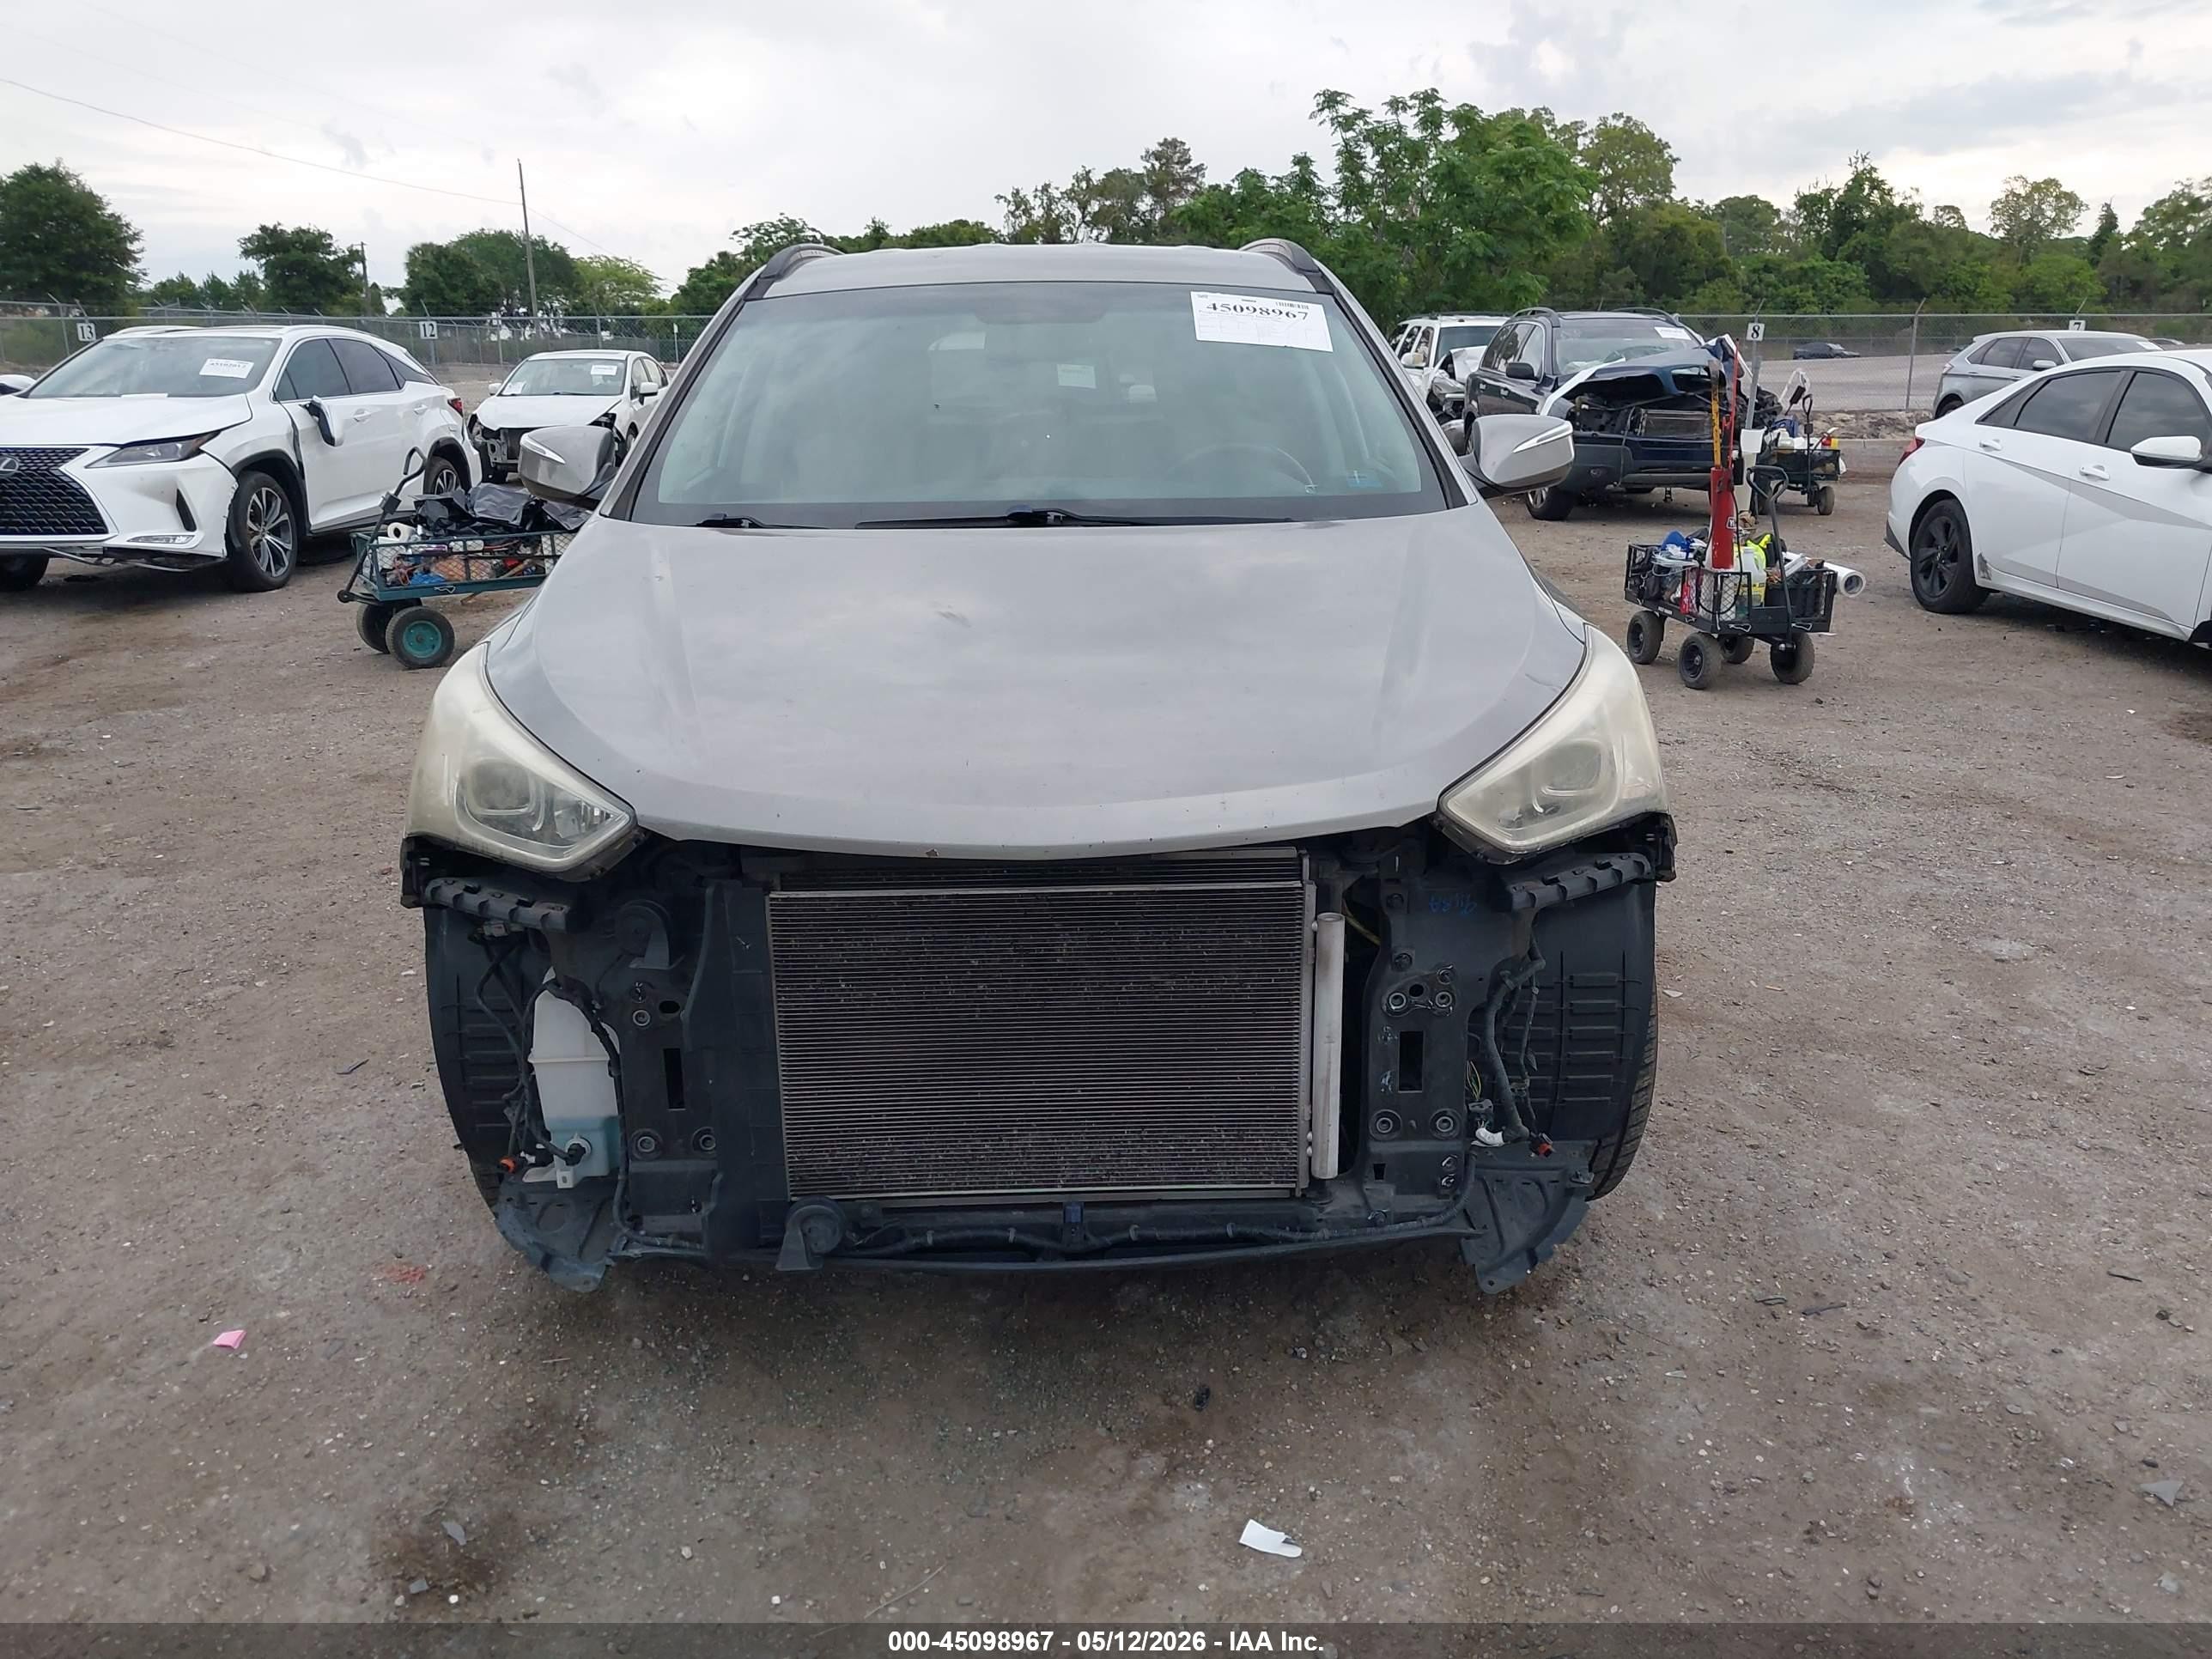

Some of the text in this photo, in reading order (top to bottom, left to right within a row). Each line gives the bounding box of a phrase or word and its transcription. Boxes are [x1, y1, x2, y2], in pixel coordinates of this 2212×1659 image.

[1206, 302, 1309, 320] 45098967
[81, 325, 94, 340] 13
[422, 325, 436, 337] 12
[1751, 325, 1760, 338] 8
